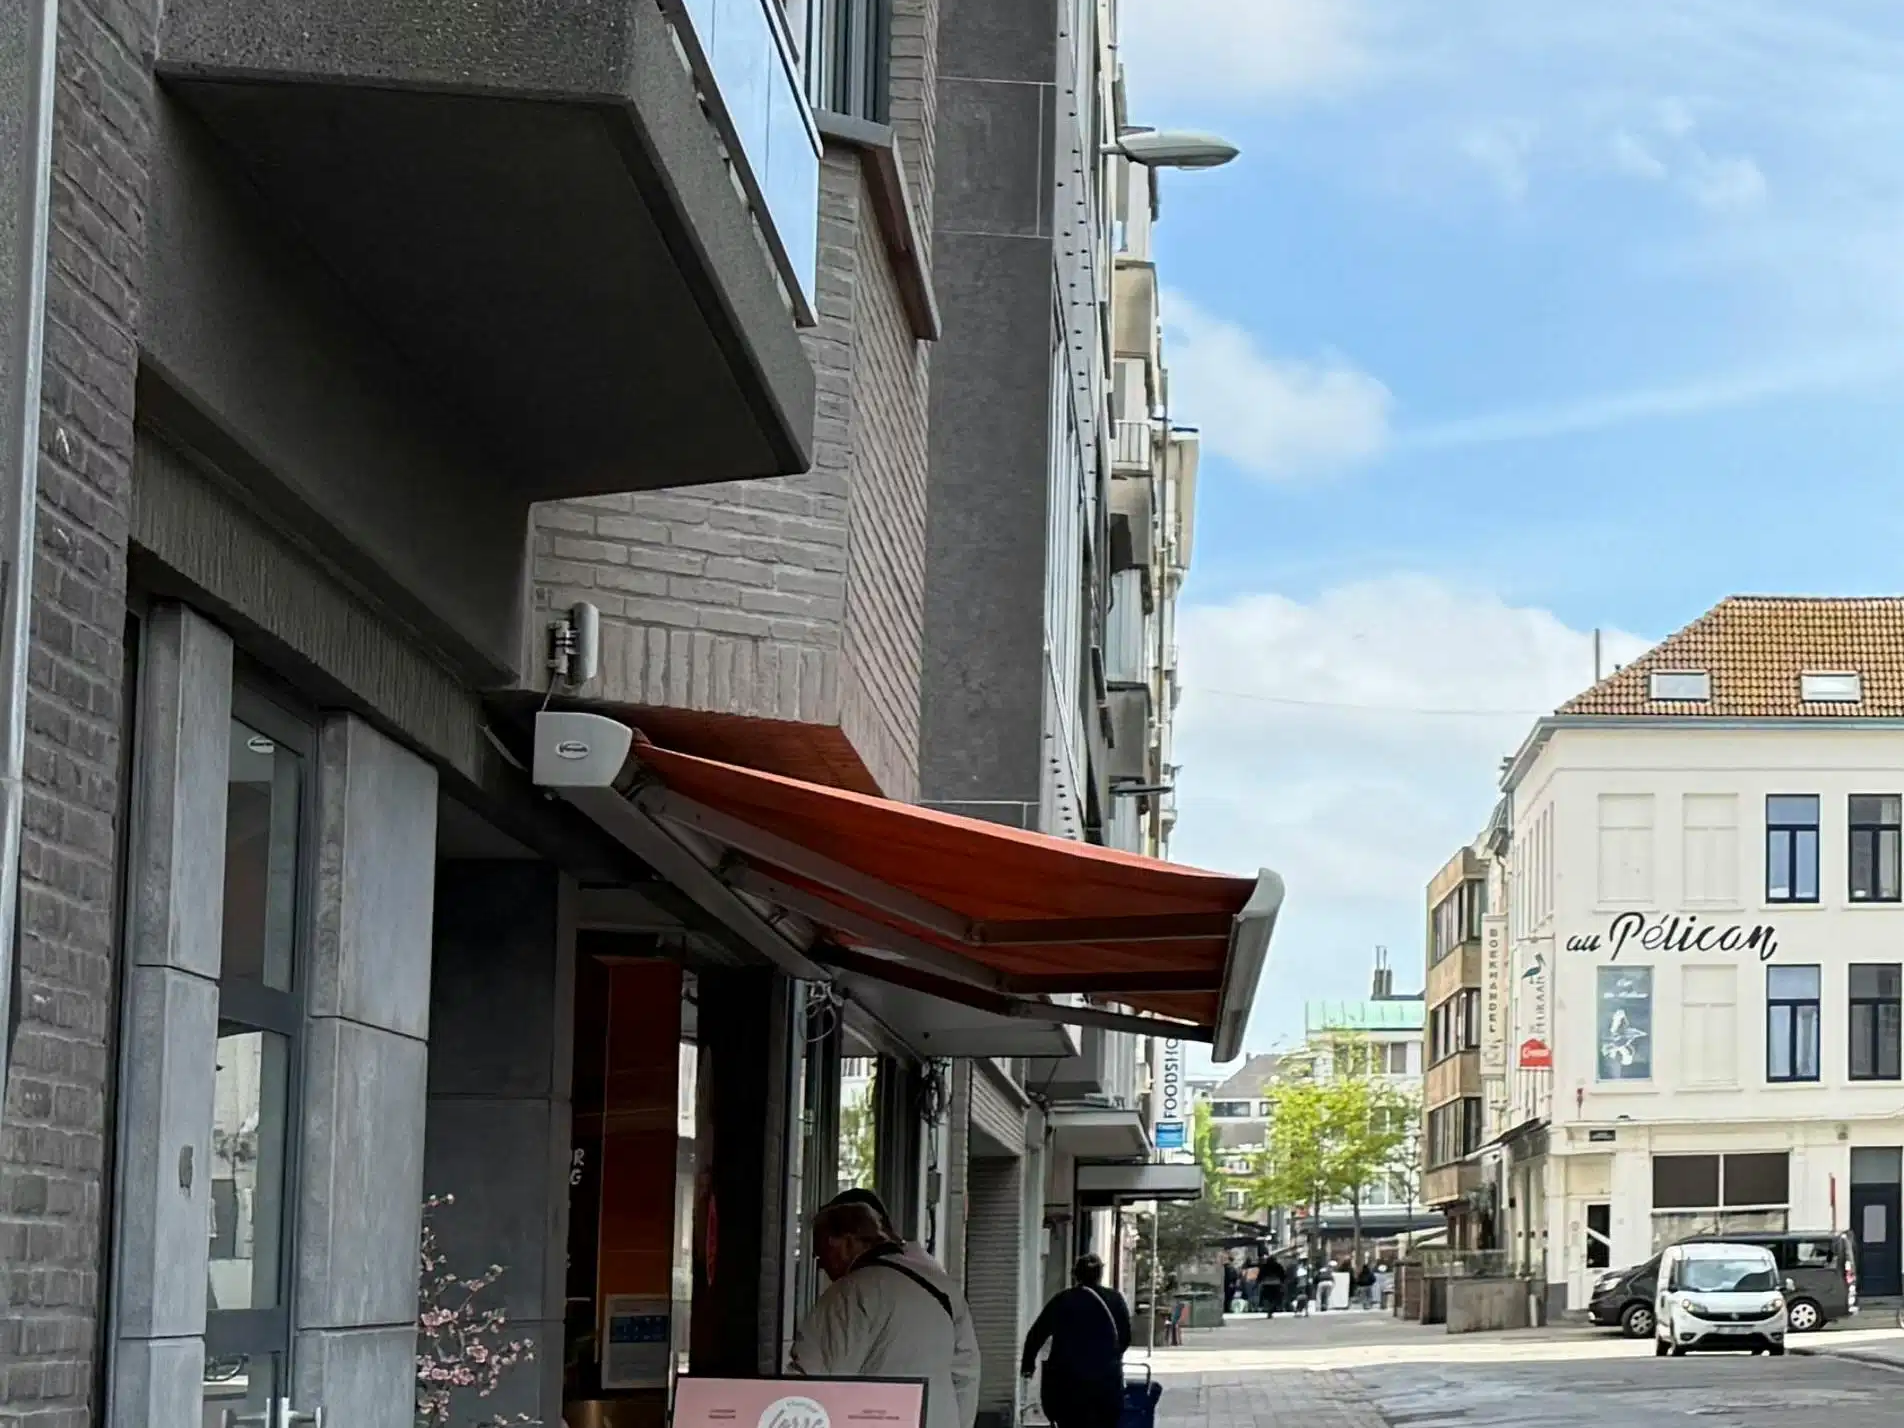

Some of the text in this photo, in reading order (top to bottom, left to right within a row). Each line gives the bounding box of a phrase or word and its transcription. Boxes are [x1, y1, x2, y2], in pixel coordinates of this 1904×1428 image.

[1609, 911, 1778, 961] Pélican
[1488, 928, 1499, 1033] BOEKHANDEL
[1164, 1037, 1179, 1119] FOODSHO
